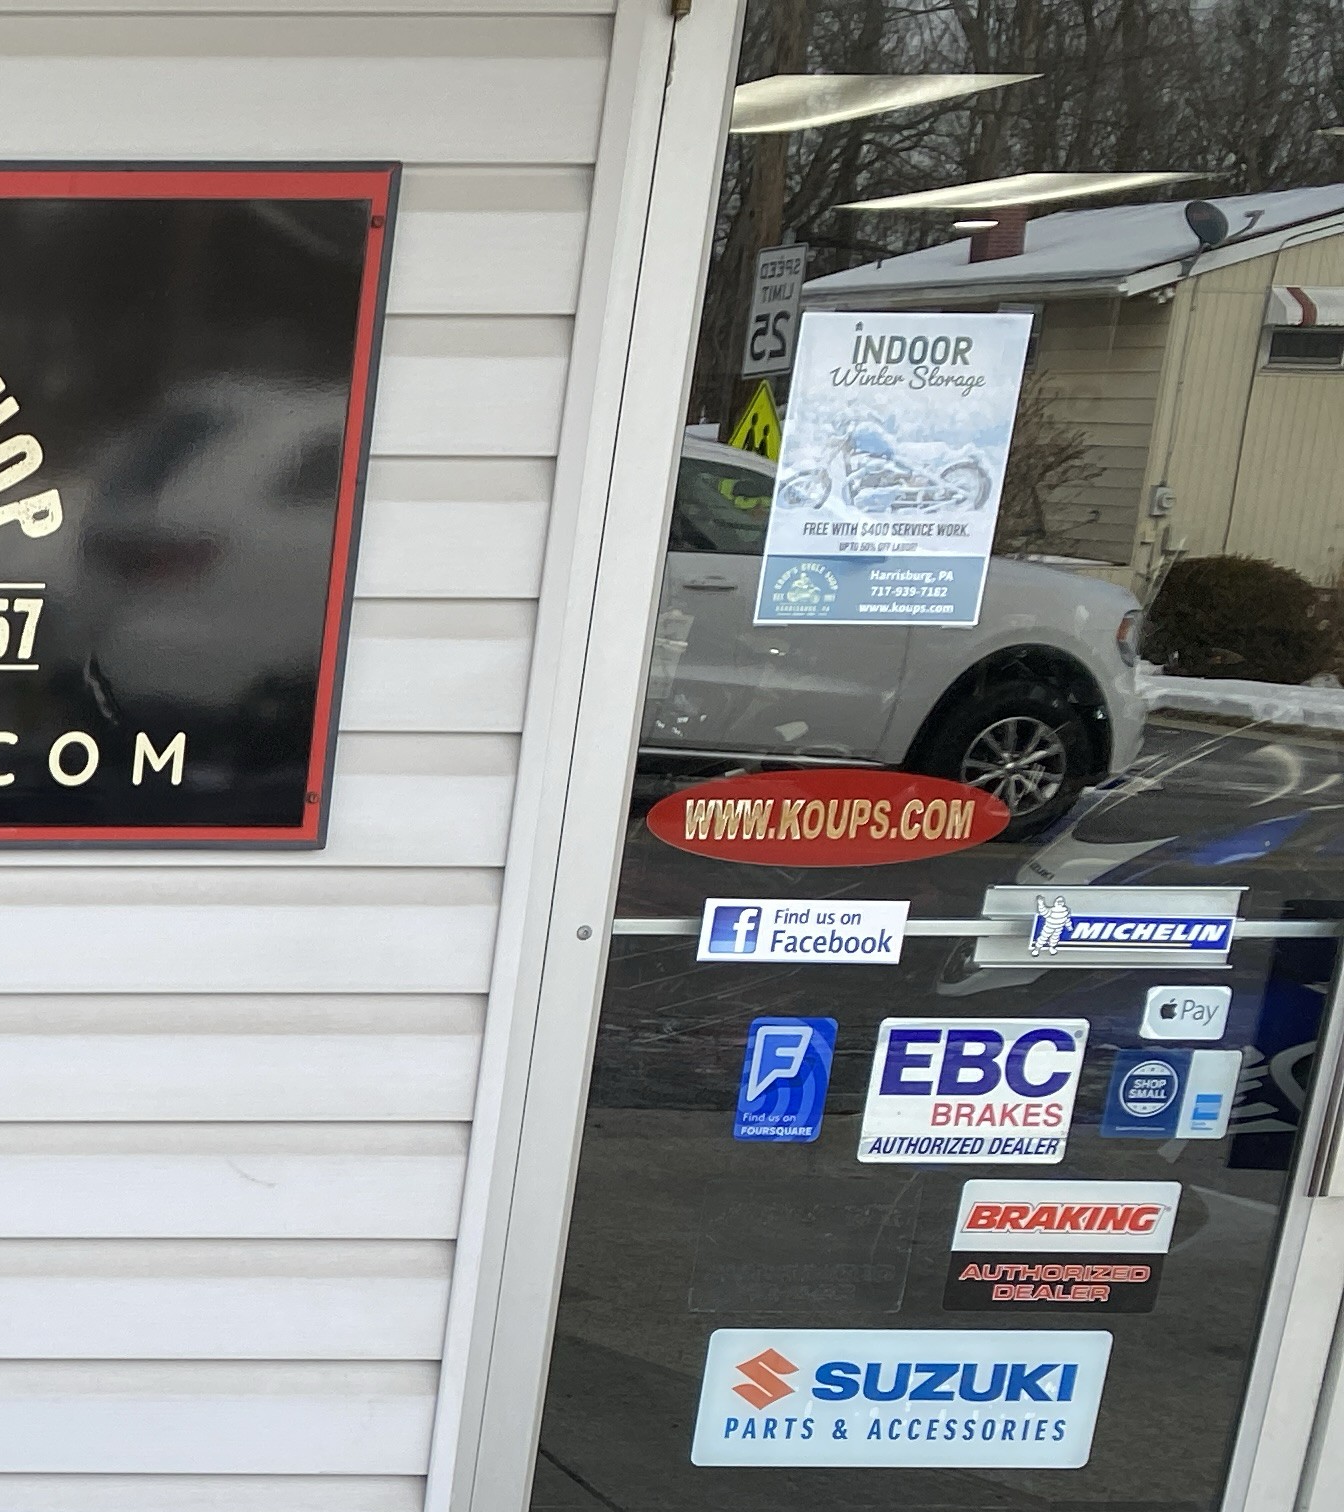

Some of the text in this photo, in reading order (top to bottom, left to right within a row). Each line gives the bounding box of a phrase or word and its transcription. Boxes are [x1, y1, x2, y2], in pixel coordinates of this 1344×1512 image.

[830, 364, 986, 397] Winter Storage
[803, 522, 829, 536] FREE
[832, 522, 858, 536] WITH
[891, 522, 935, 537] SERVICE
[939, 571, 954, 581] PA
[859, 603, 954, 616] www.koups.com
[684, 799, 976, 840] WWW.KOUPS.COM
[774, 908, 862, 925] Find us on
[770, 929, 893, 953] Facebook
[1071, 922, 1227, 941] MICHELIN
[1181, 999, 1220, 1026] Pay
[879, 1028, 1077, 1098] EBC
[1128, 1088, 1168, 1099] SMALL
[1133, 1079, 1167, 1088] SHOP
[742, 1112, 797, 1123] Find us on
[931, 1103, 1063, 1127] BRAKES
[741, 1126, 813, 1137] FOURSQUARE
[868, 1136, 1062, 1156] AUTHORIZED DEALER
[963, 1203, 1165, 1234] BRAKING
[959, 1263, 1151, 1283] AUTHORIZED
[992, 1284, 1111, 1302] DEALER
[812, 1361, 1079, 1402] SUZUKI
[724, 1417, 1067, 1441] PARTS & ACCESSORIES
